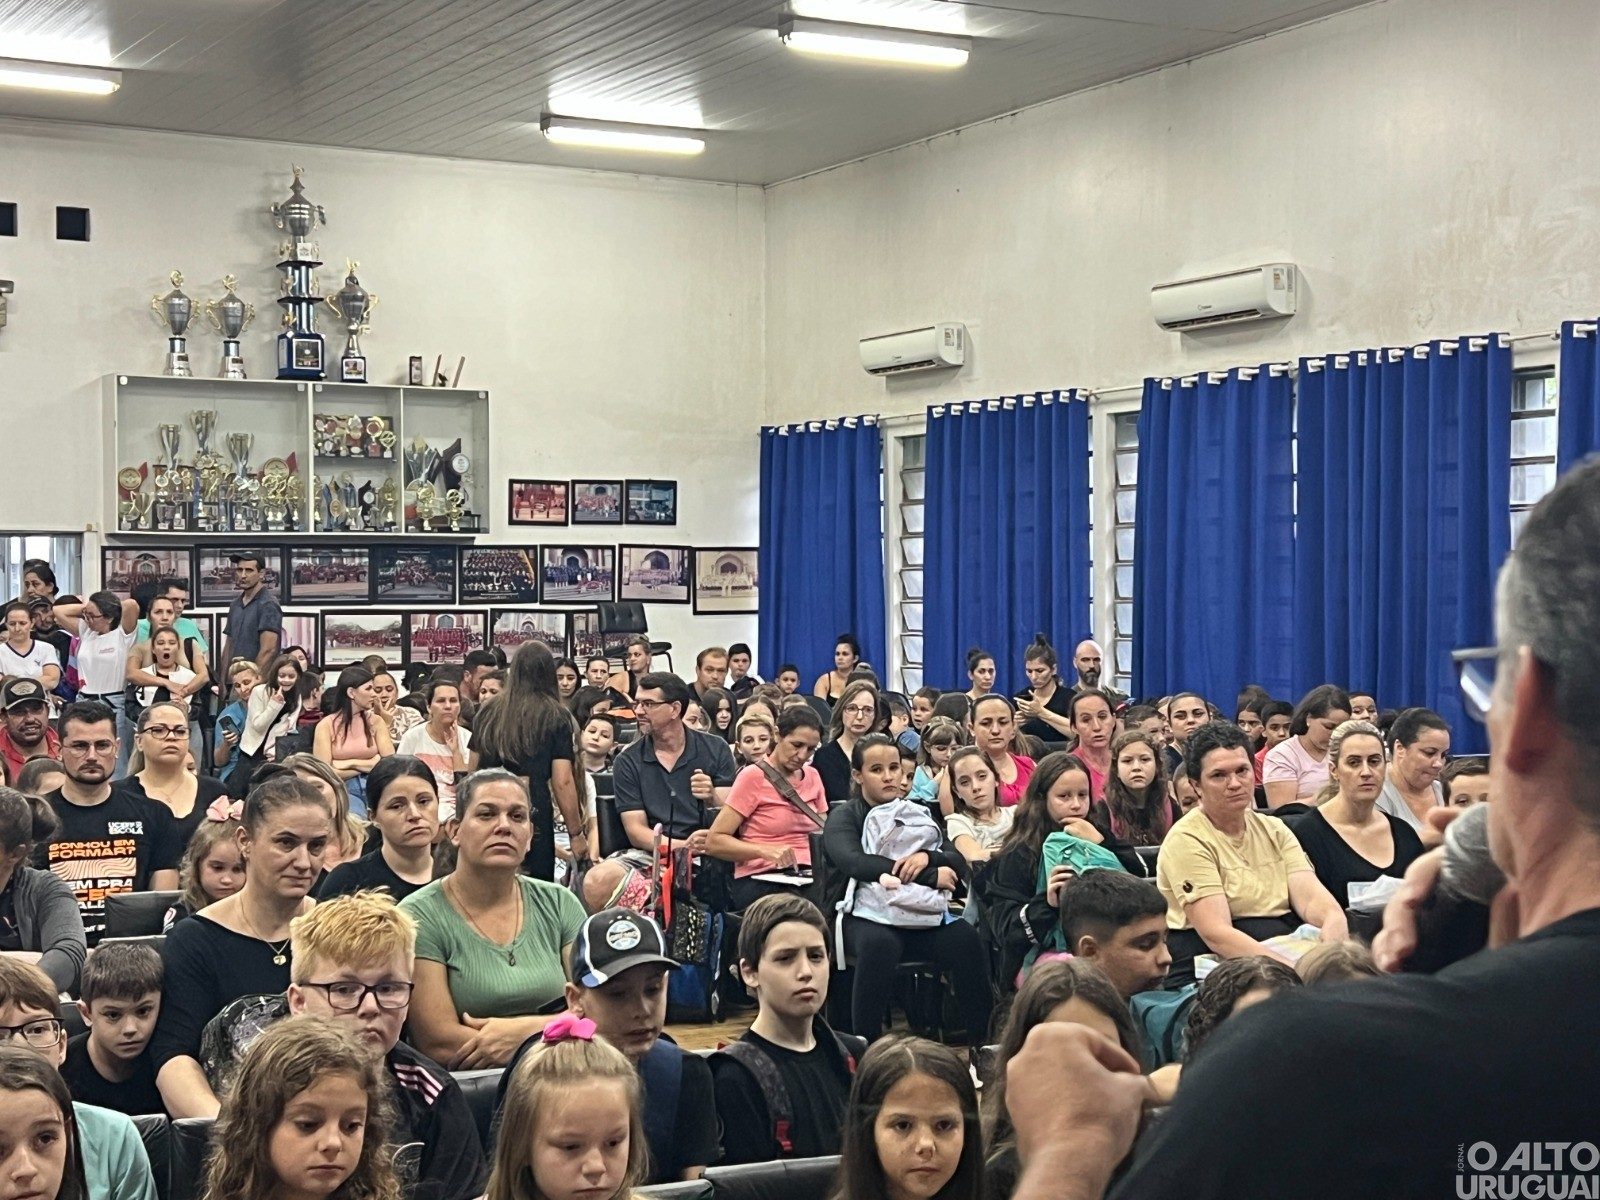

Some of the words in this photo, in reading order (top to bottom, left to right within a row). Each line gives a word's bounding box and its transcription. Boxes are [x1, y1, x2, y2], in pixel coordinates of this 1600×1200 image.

[48, 841, 111, 851] SONHOU
[113, 839, 136, 848] EM
[97, 878, 133, 889] PRA
